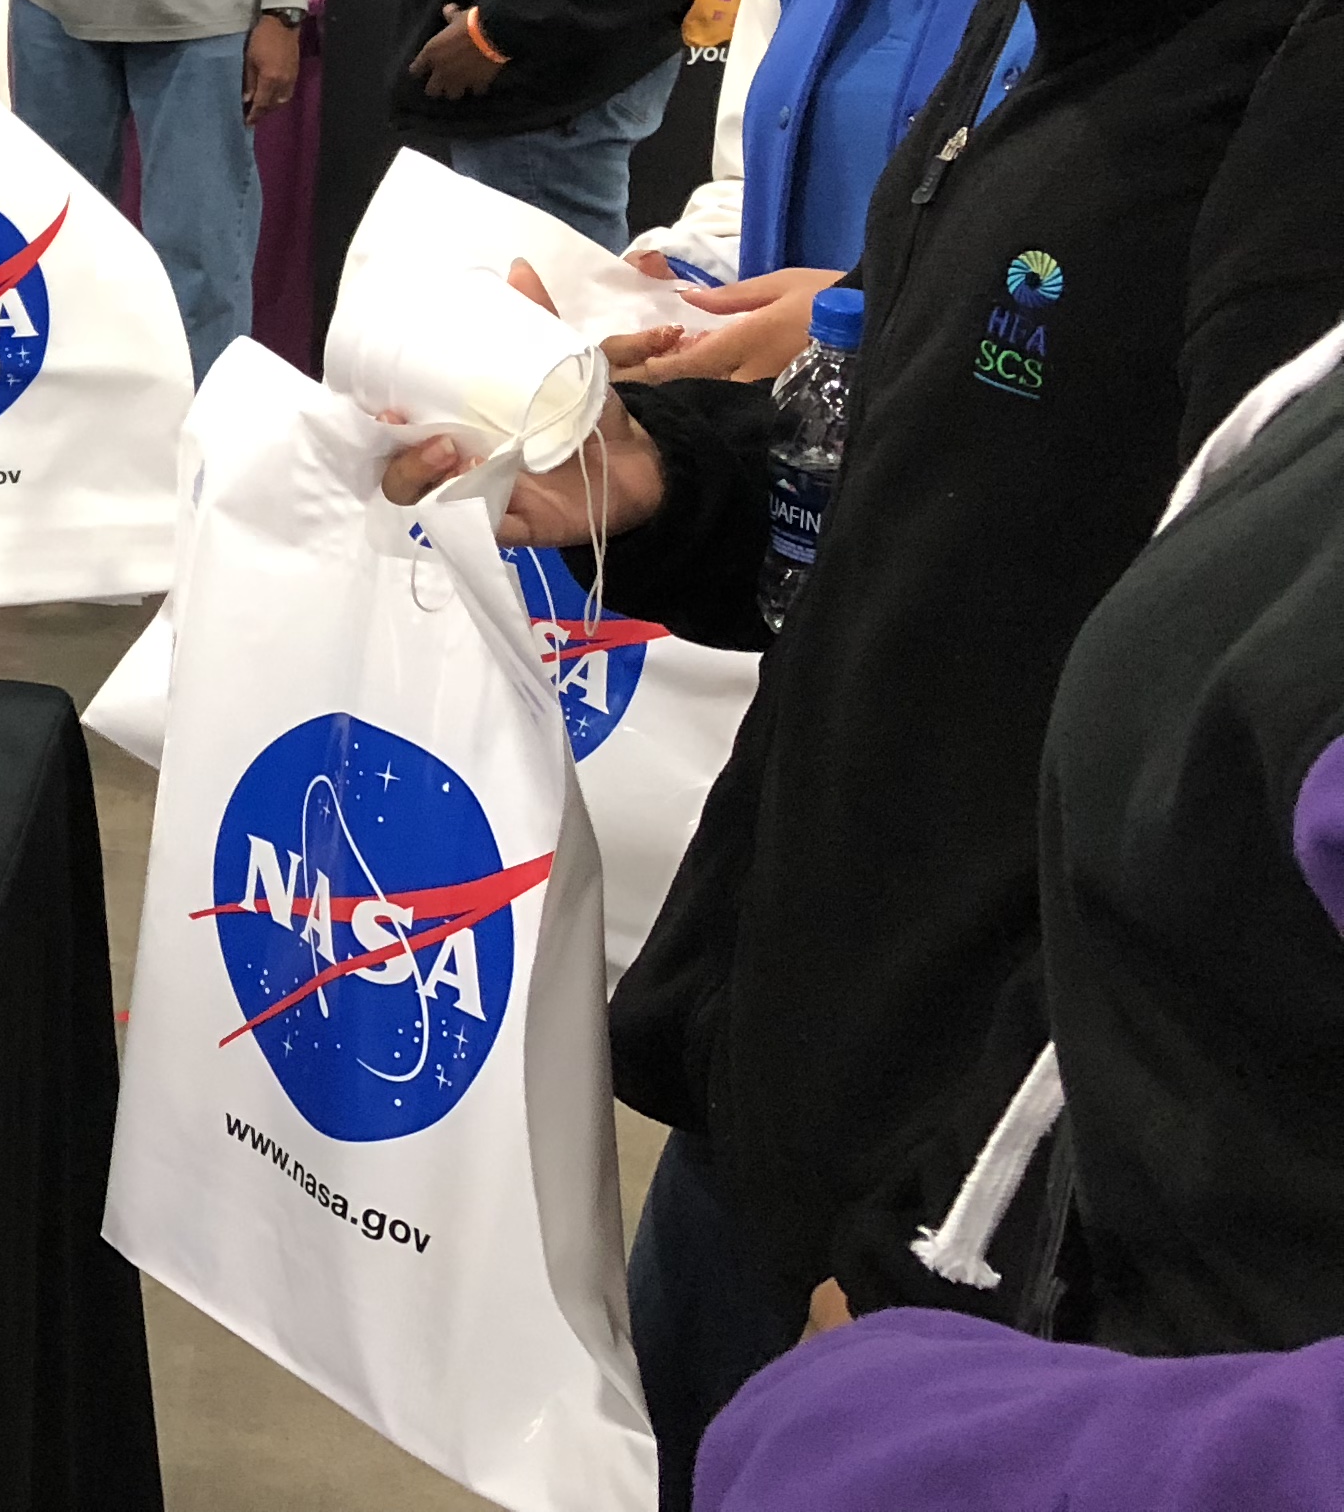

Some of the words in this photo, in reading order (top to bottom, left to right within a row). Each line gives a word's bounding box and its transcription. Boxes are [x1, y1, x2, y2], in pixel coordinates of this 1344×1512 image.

[974, 339, 1043, 388] SCS
[769, 492, 821, 534] UAFIN
[532, 621, 610, 716] SA
[239, 834, 487, 1022] NASA
[225, 1112, 431, 1254] www.nasa.gov
